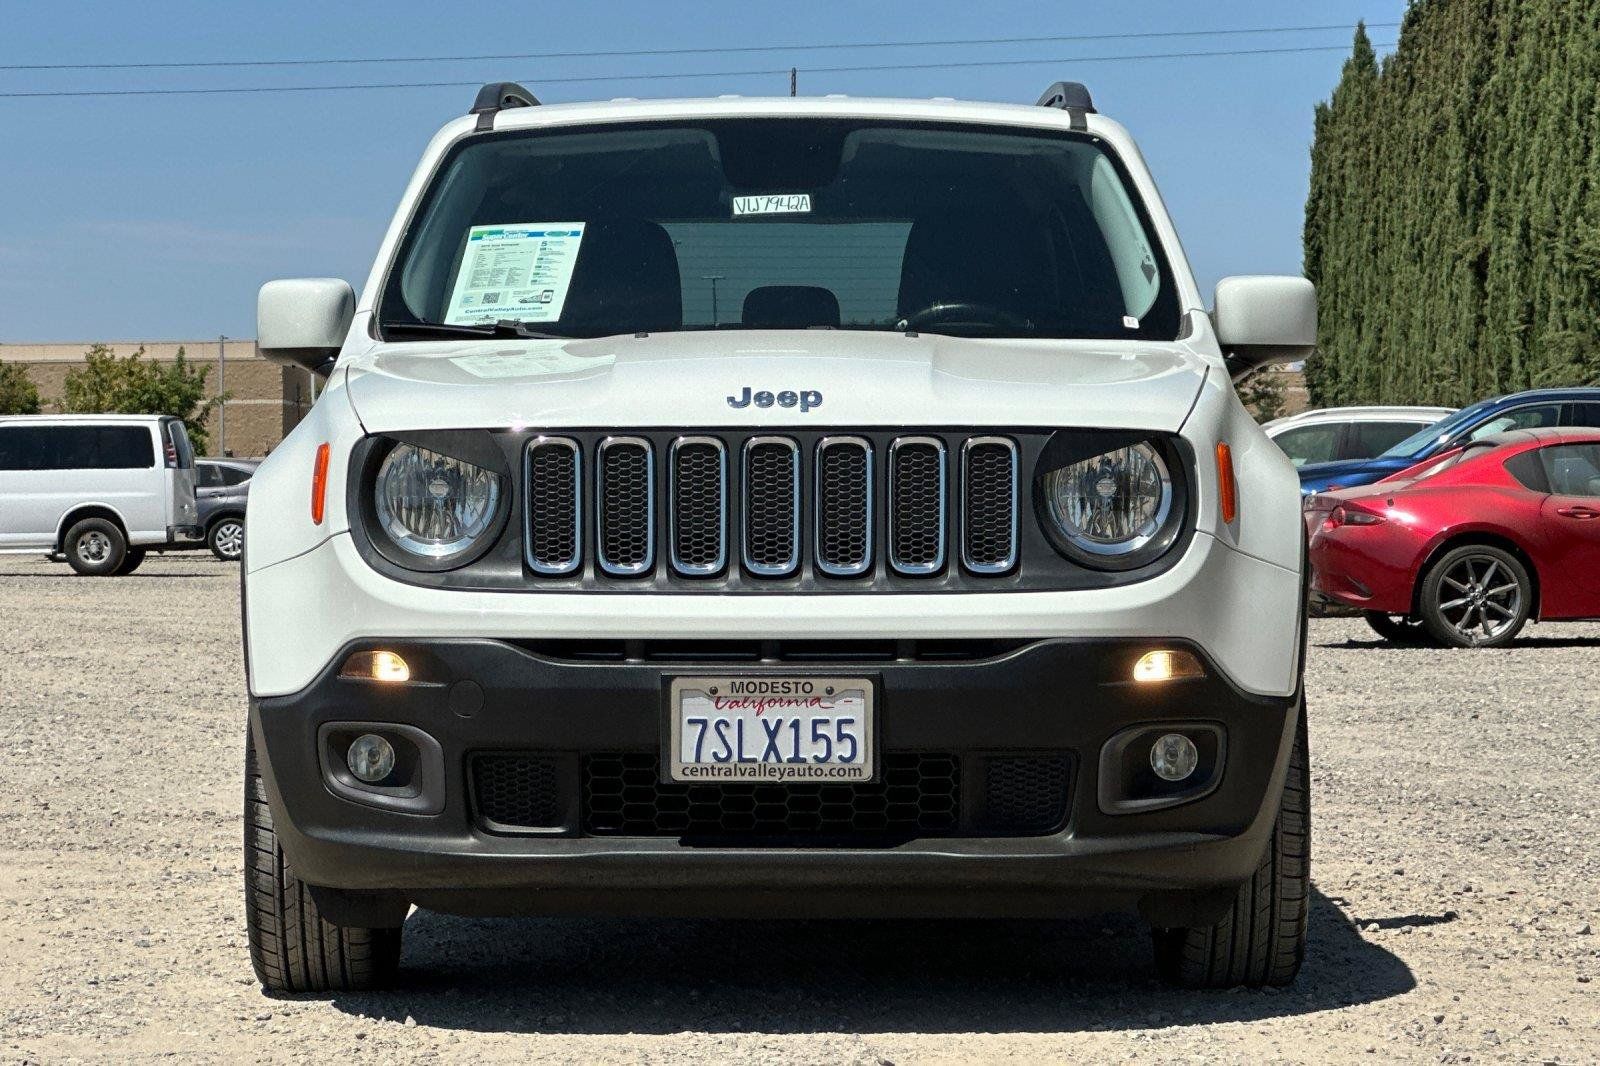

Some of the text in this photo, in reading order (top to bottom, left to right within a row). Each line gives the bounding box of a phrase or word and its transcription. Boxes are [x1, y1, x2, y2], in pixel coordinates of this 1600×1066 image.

[735, 196, 809, 213] VW7942A
[465, 306, 543, 314] CentralValleyAuto.com
[726, 386, 823, 413] Jeep
[731, 681, 814, 695] MODESTO
[714, 696, 834, 717] California
[687, 718, 857, 763] 7SLX155
[682, 763, 863, 780] centralvalleyauto.com
